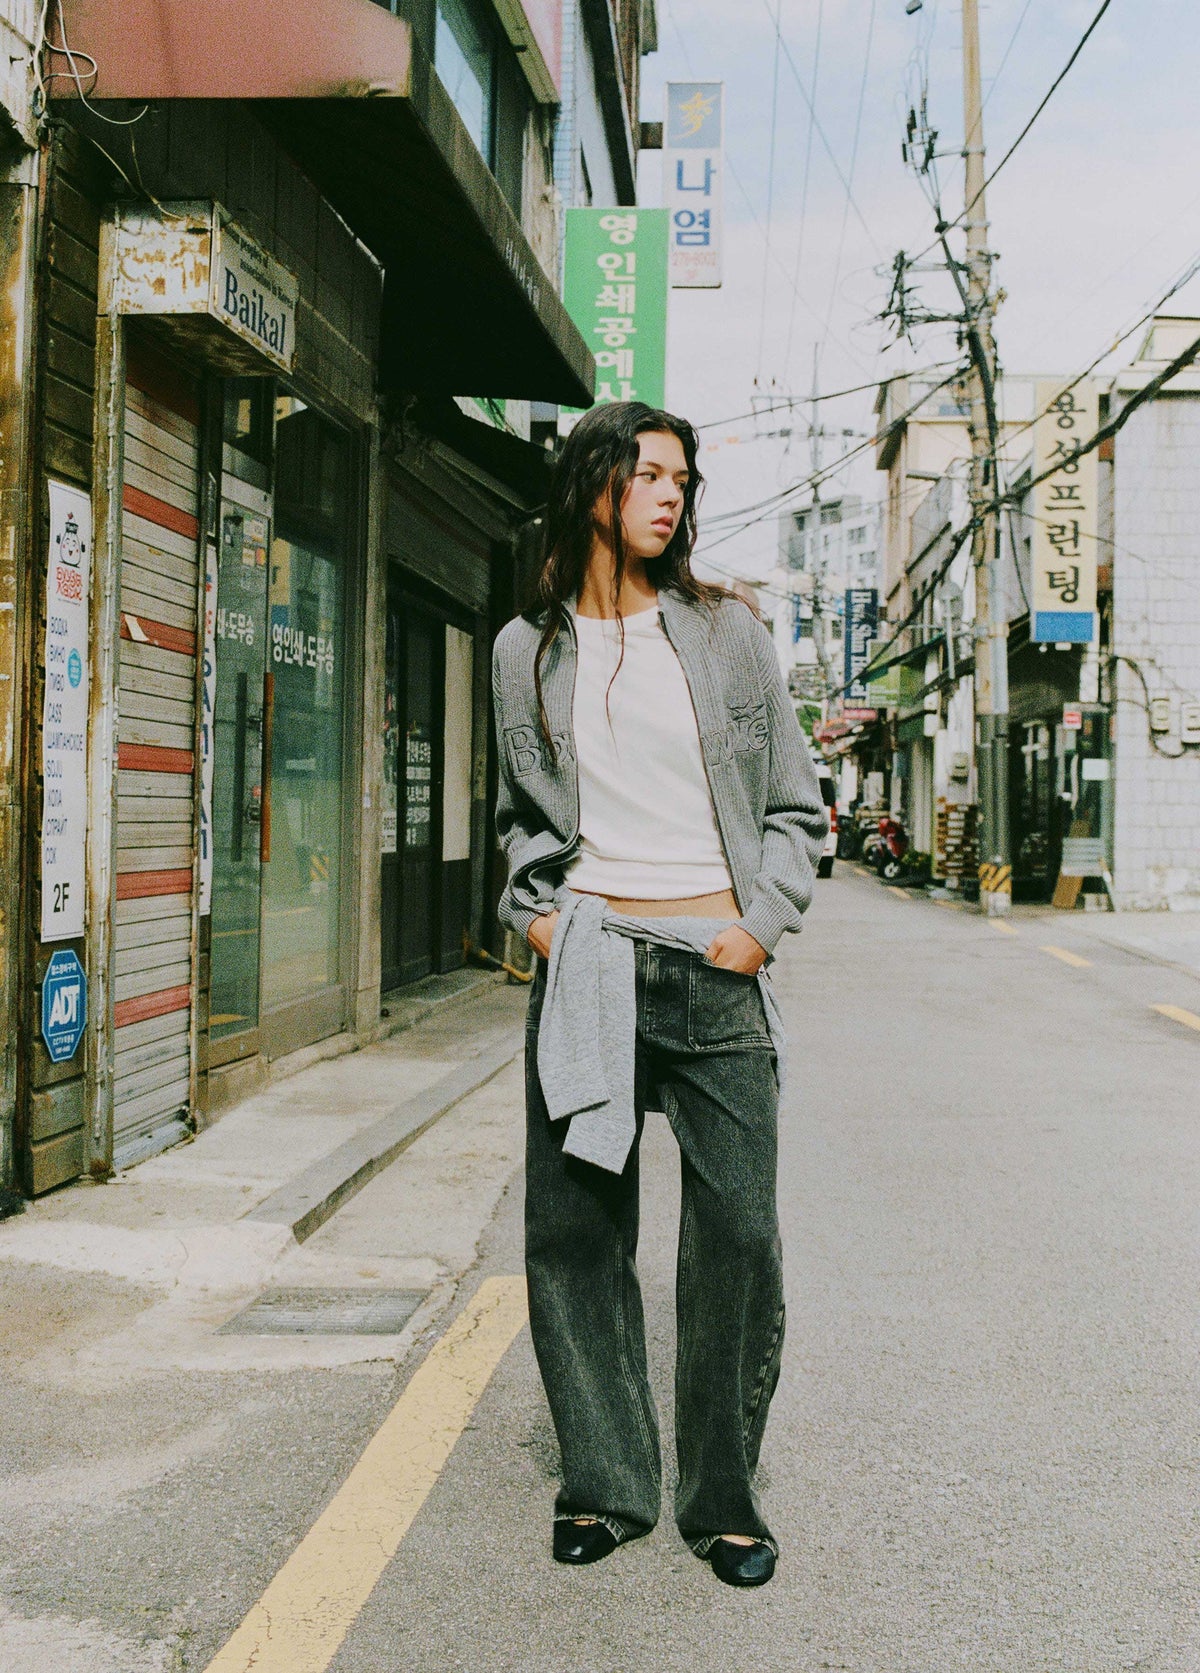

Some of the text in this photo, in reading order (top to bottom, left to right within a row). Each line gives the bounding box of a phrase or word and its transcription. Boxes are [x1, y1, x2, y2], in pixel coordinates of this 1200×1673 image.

[673, 158, 716, 246] 나염
[223, 267, 287, 355] Baikal
[1045, 391, 1086, 603] 용성프린팅
[53, 882, 70, 913] 2F
[48, 984, 81, 1028] ADT
